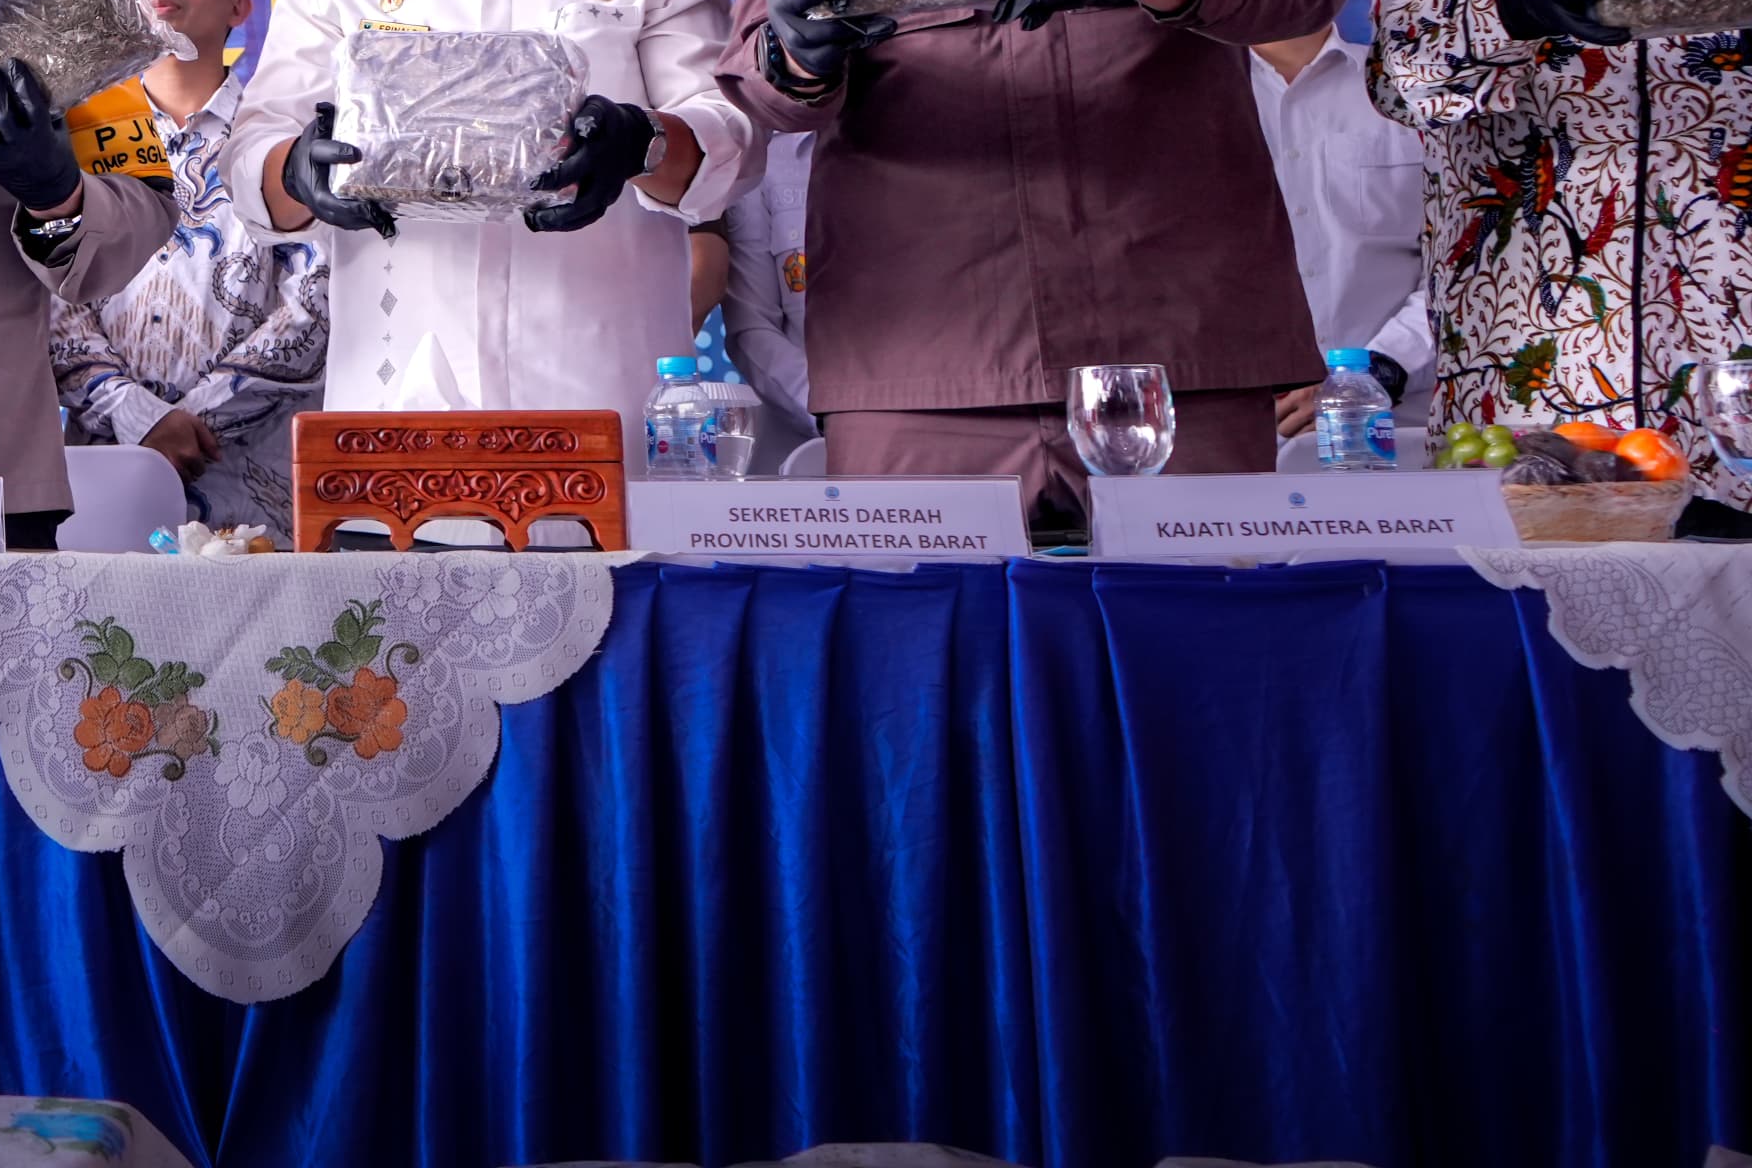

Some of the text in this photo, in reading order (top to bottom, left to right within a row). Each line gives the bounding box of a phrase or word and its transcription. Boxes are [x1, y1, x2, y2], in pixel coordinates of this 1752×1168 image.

[729, 507, 942, 524] SEKRETARIS DAERAH
[1156, 518, 1455, 538] KAJATI SUMATERA BARAT
[690, 533, 988, 549] PROVINSI SUMATERA BARAT
